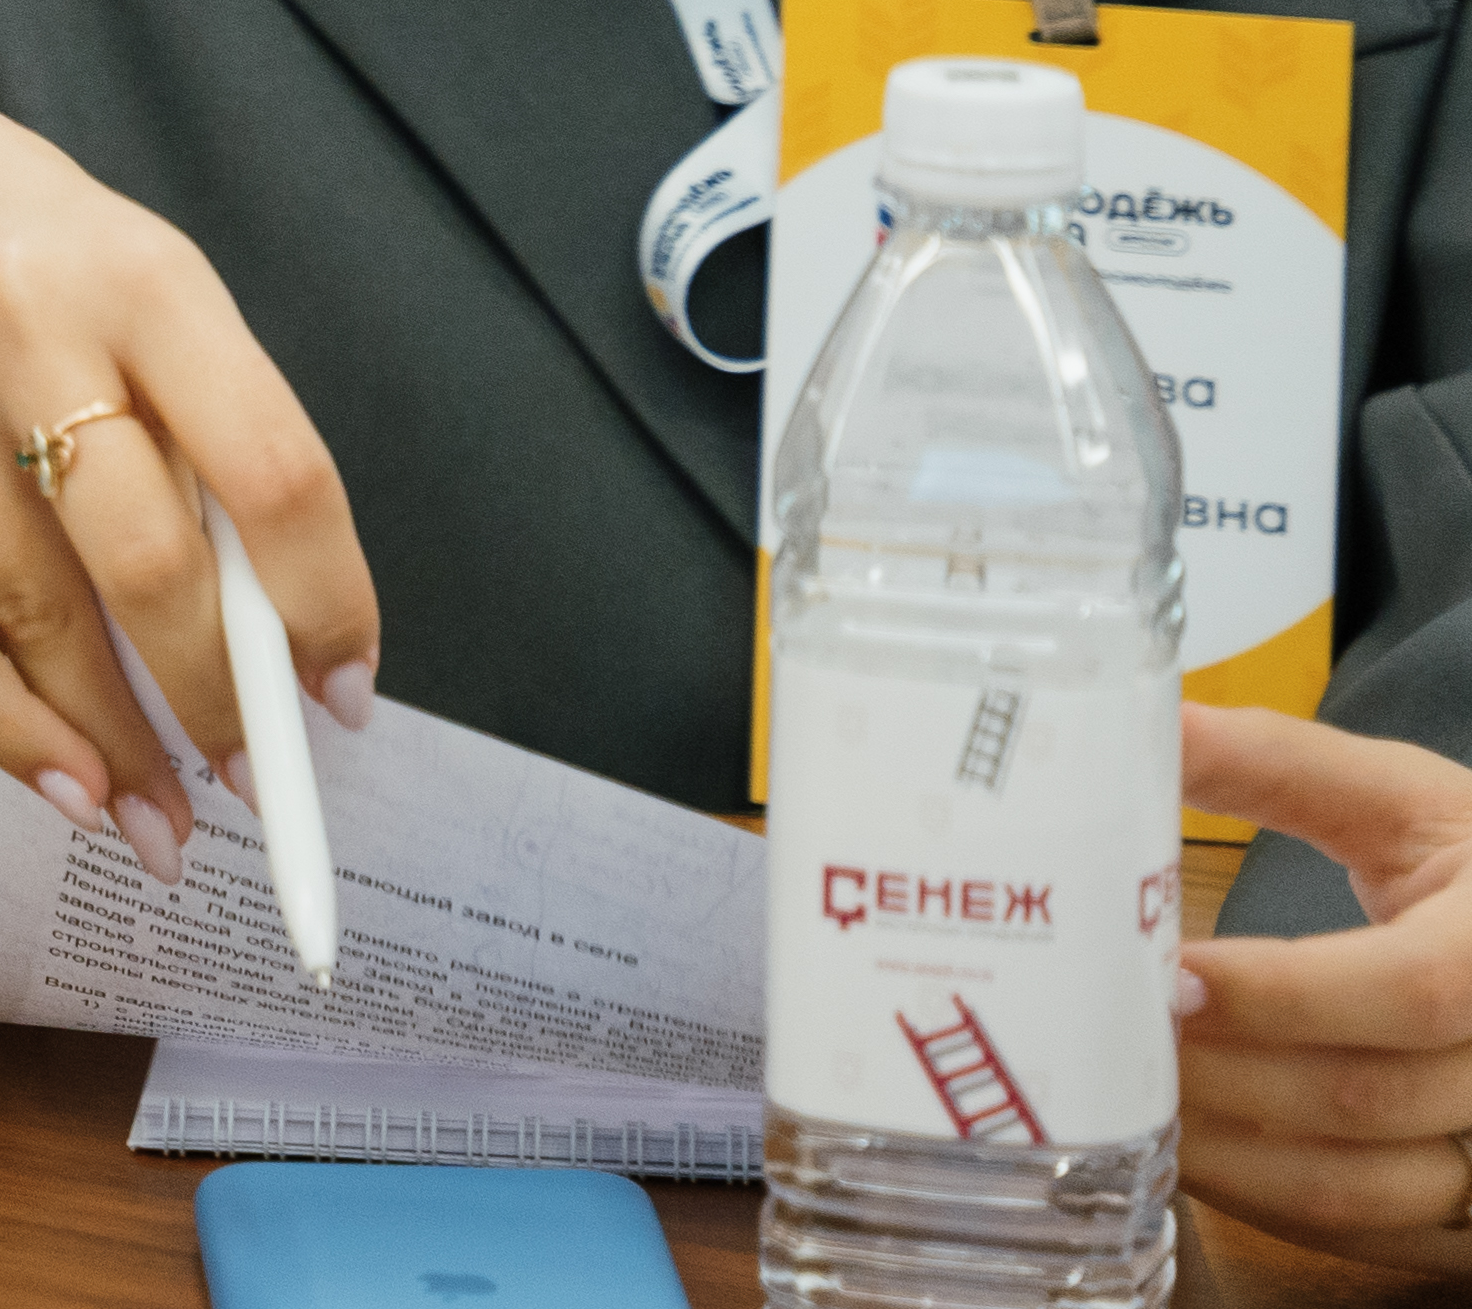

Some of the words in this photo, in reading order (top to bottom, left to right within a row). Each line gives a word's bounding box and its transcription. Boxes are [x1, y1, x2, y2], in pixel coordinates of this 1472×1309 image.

[63, 870, 231, 938] Ленинградской
[66, 853, 143, 891] завода
[168, 891, 182, 904] в
[821, 862, 1053, 932] СЕНЕЖ
[55, 909, 136, 945] частью
[156, 942, 275, 984] местными
[58, 890, 137, 927] заводе
[149, 921, 296, 974] планируется
[462, 903, 541, 941] завод
[550, 931, 565, 945] в
[44, 975, 107, 1000] Ваша
[114, 993, 194, 1017] задача
[48, 945, 144, 981] стороны
[151, 973, 249, 1006] местных
[51, 928, 219, 984] строительстве
[231, 980, 311, 1007] завода
[81, 996, 100, 1011] 1)
